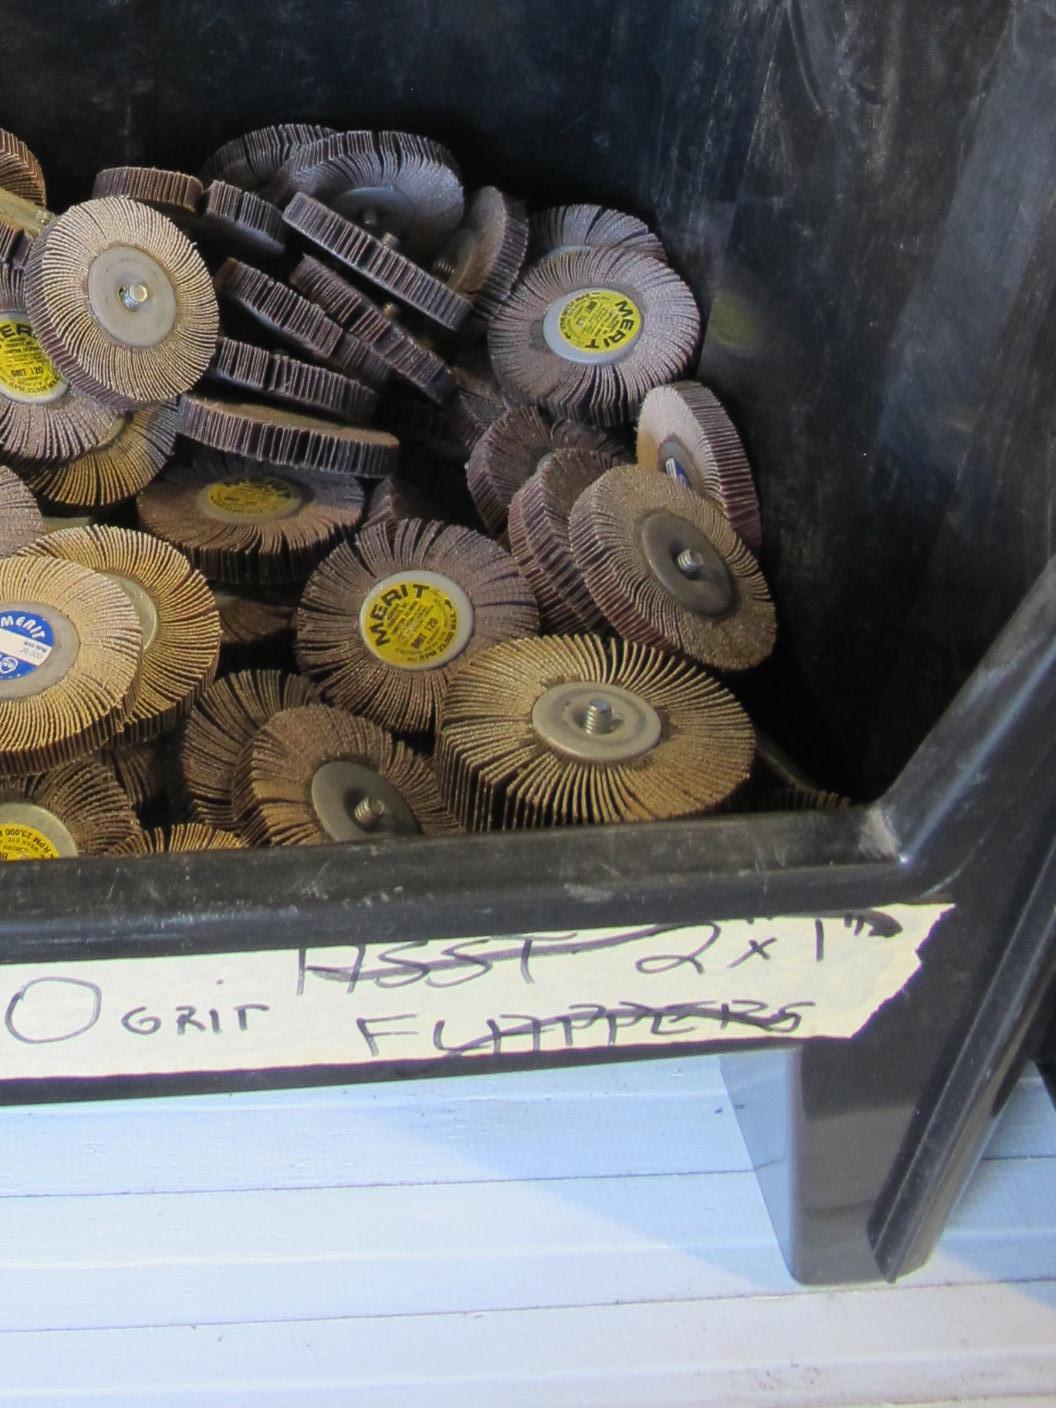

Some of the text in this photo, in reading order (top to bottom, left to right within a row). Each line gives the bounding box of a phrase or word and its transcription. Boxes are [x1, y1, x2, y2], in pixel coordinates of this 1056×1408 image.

[585, 300, 635, 349] MERIT
[0, 615, 45, 638] MERIT
[370, 584, 430, 647] MERIT
[121, 1003, 270, 1036] GRIT
[356, 999, 816, 1058] FLAPPERS
